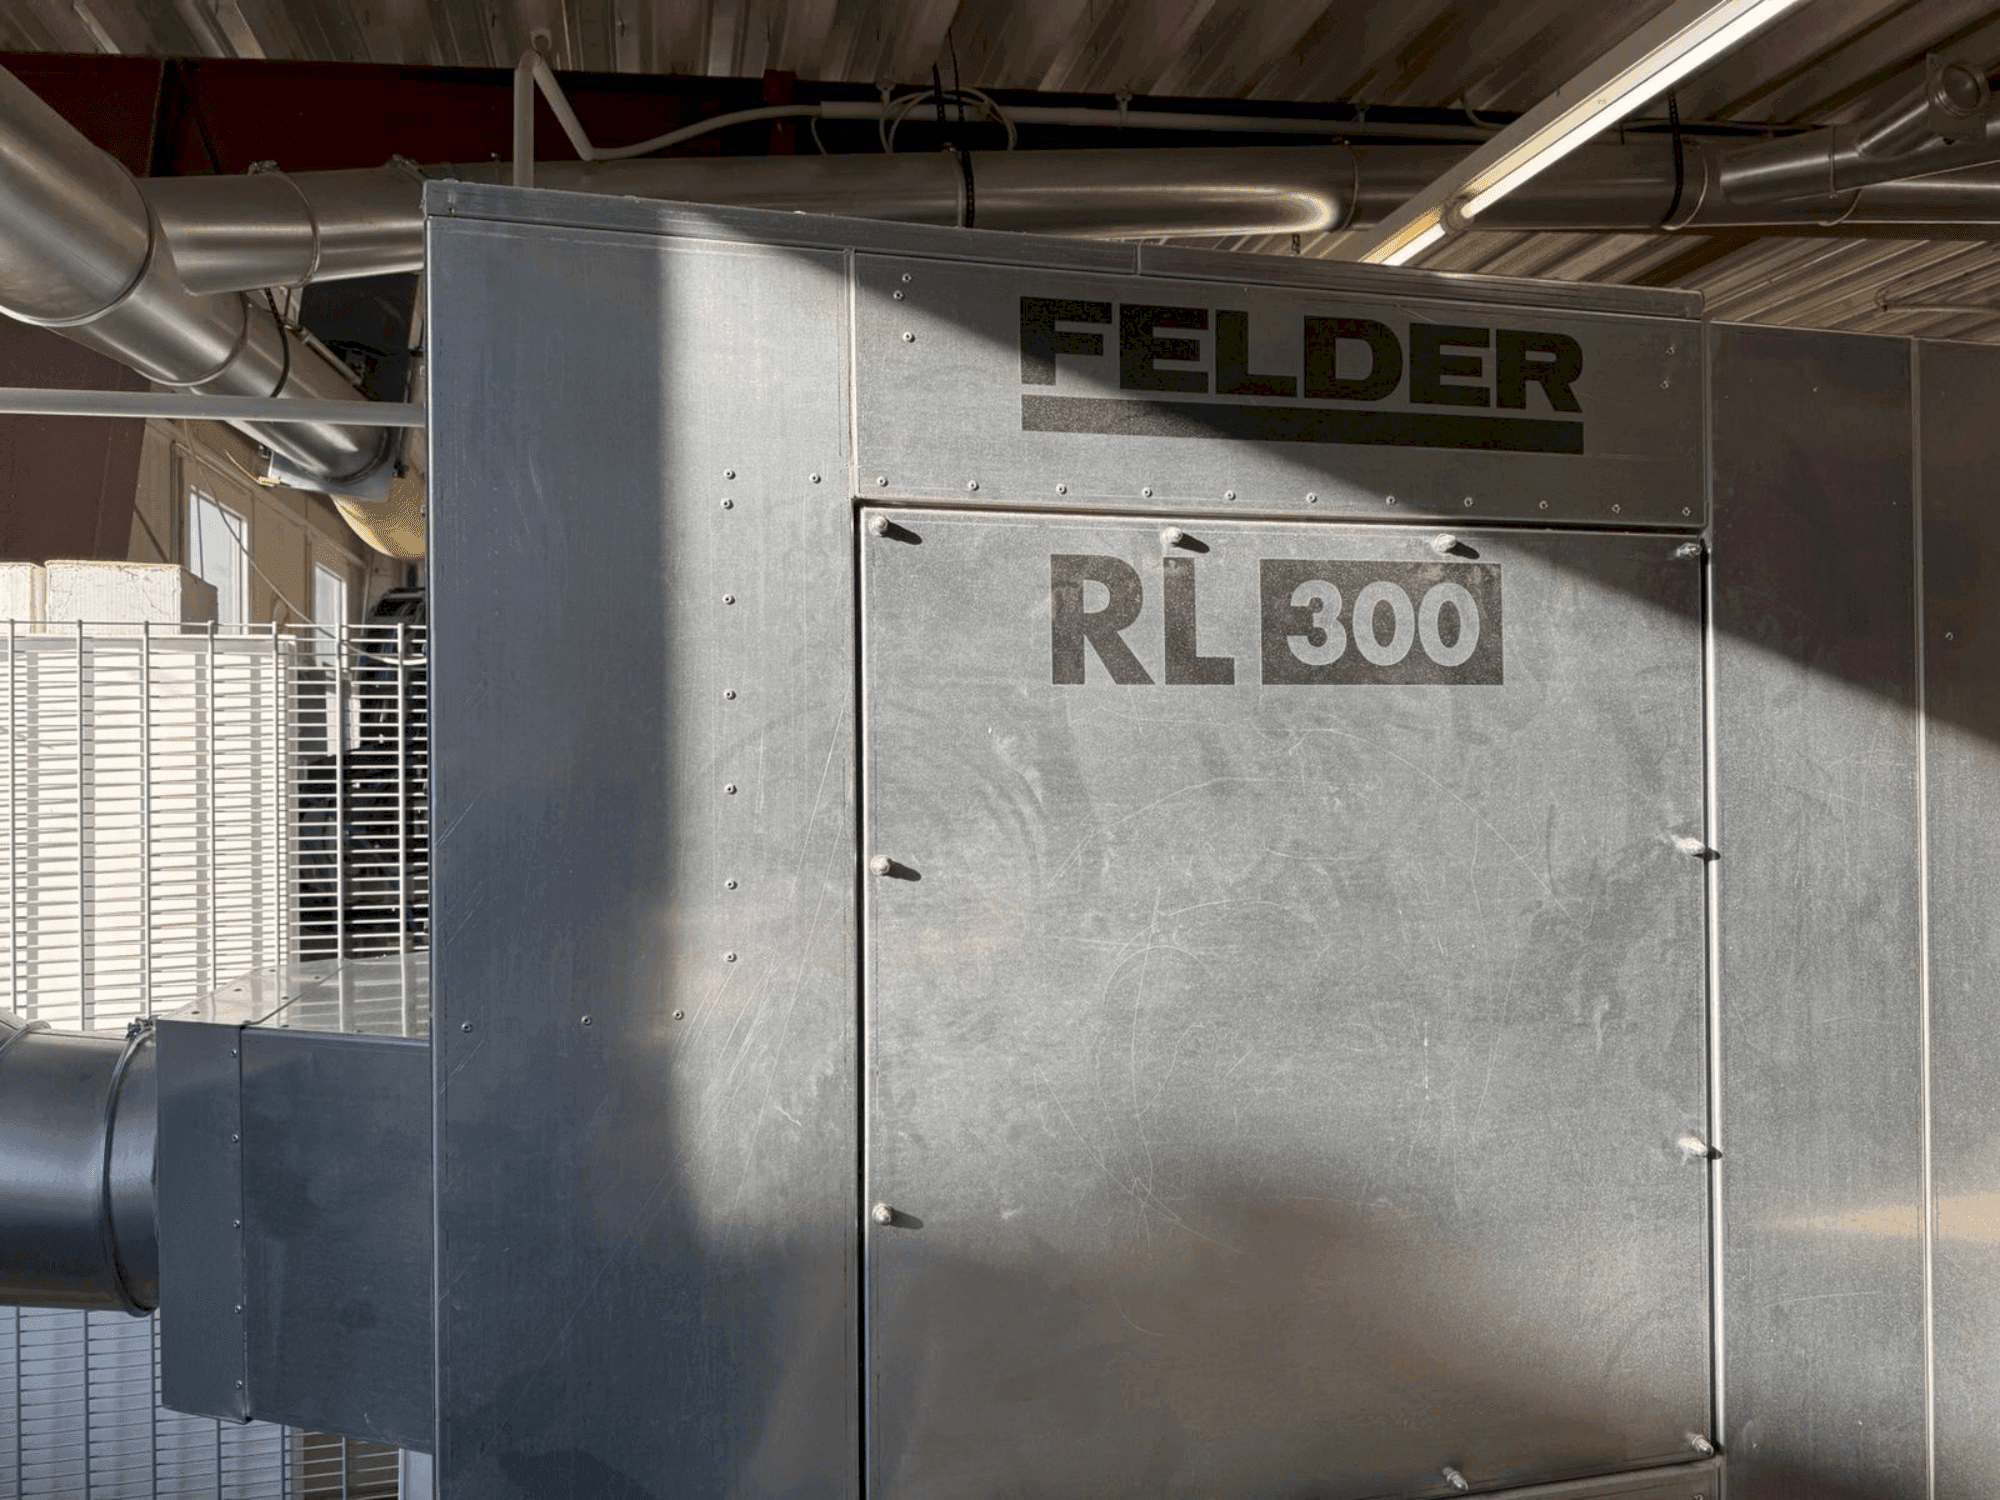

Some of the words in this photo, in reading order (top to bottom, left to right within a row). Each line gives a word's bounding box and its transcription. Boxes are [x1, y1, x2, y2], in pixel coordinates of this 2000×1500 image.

[1020, 296, 1583, 413] FELDER
[1050, 554, 1235, 685] RL
[1286, 579, 1480, 666] 300
